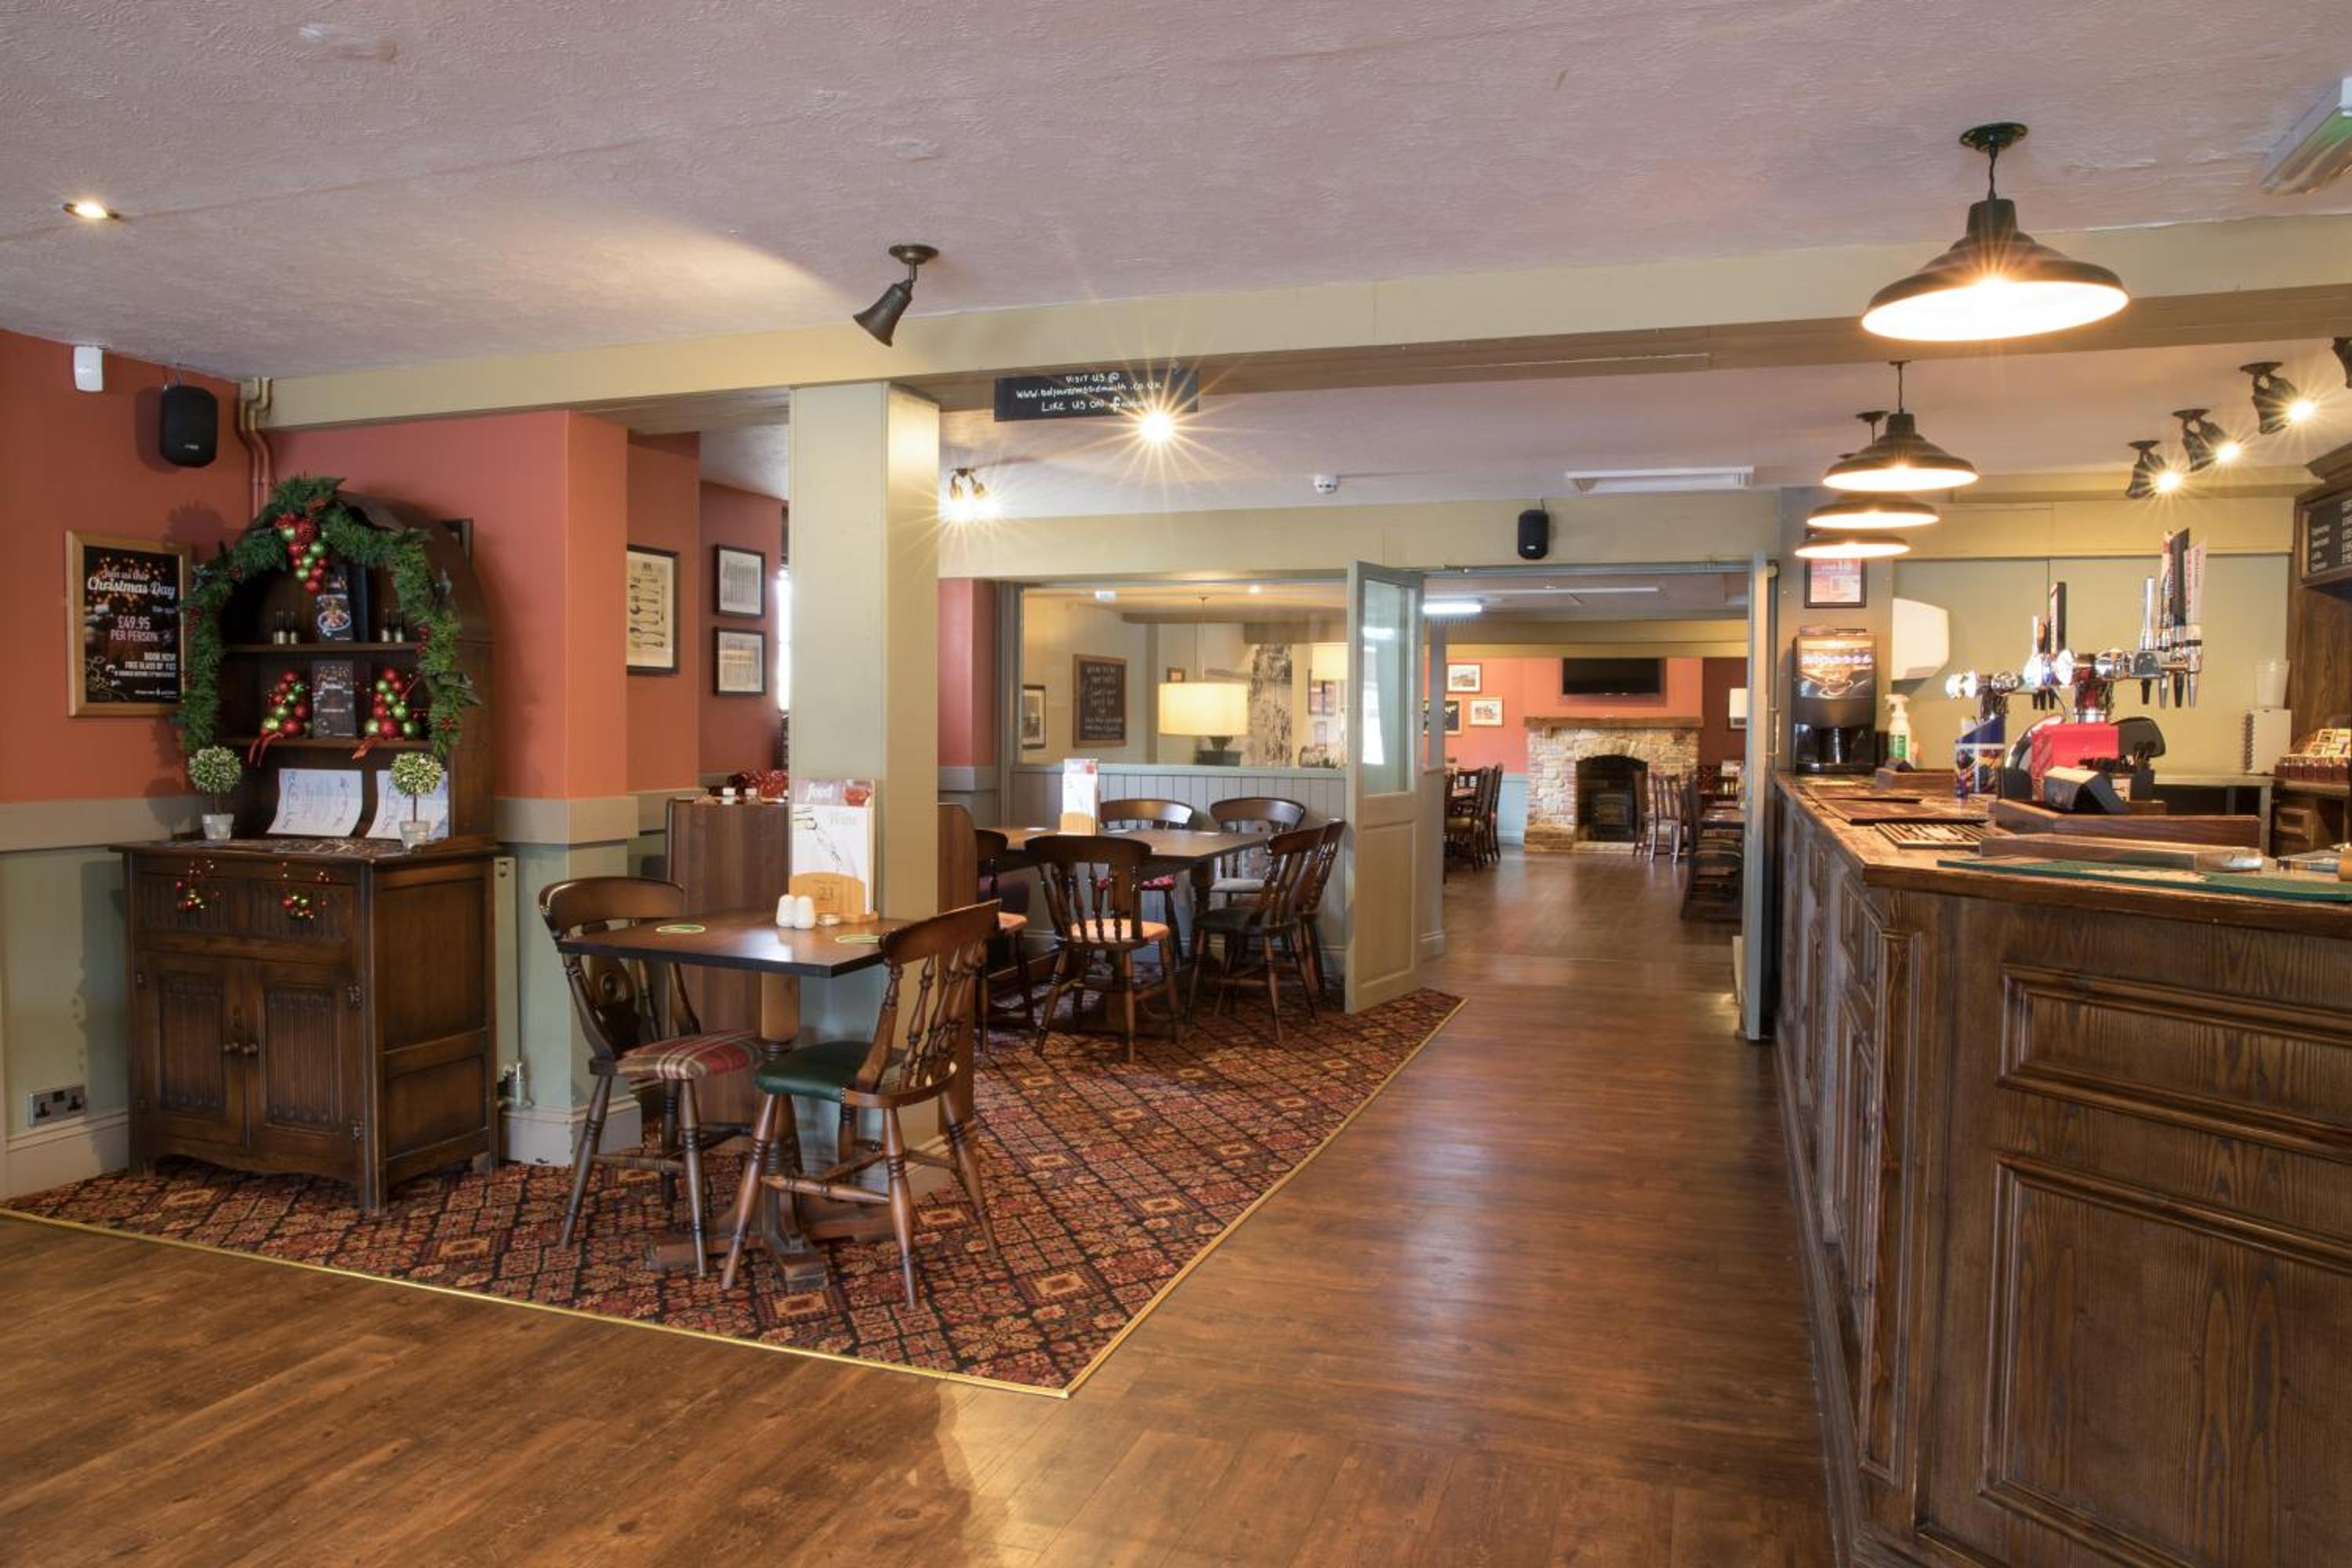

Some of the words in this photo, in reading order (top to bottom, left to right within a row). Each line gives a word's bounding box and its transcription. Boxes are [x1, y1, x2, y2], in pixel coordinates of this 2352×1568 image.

[1072, 400, 1086, 410] US
[87, 576, 148, 595] Christmas
[150, 581, 175, 599] Day
[111, 629, 125, 641] PER
[128, 630, 159, 642] PERSON
